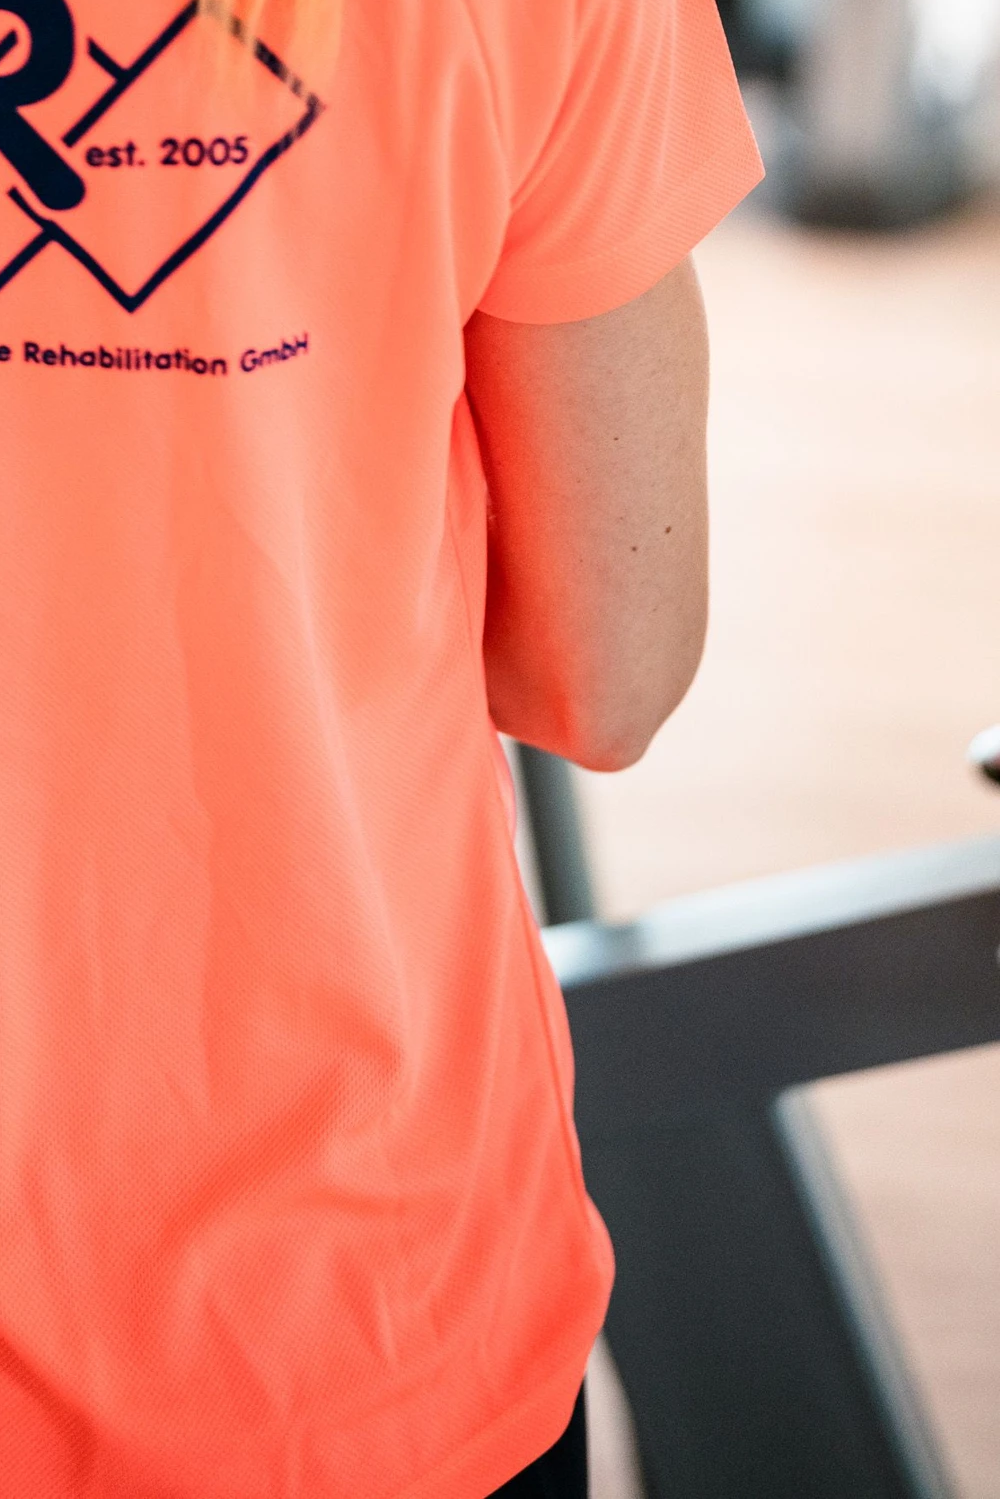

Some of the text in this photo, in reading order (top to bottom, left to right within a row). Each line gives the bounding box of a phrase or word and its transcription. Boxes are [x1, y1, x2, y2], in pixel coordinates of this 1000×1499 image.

[86, 136, 248, 168] est. 2005
[24, 341, 227, 375] Rehabilitation
[241, 332, 308, 373] GmbH
